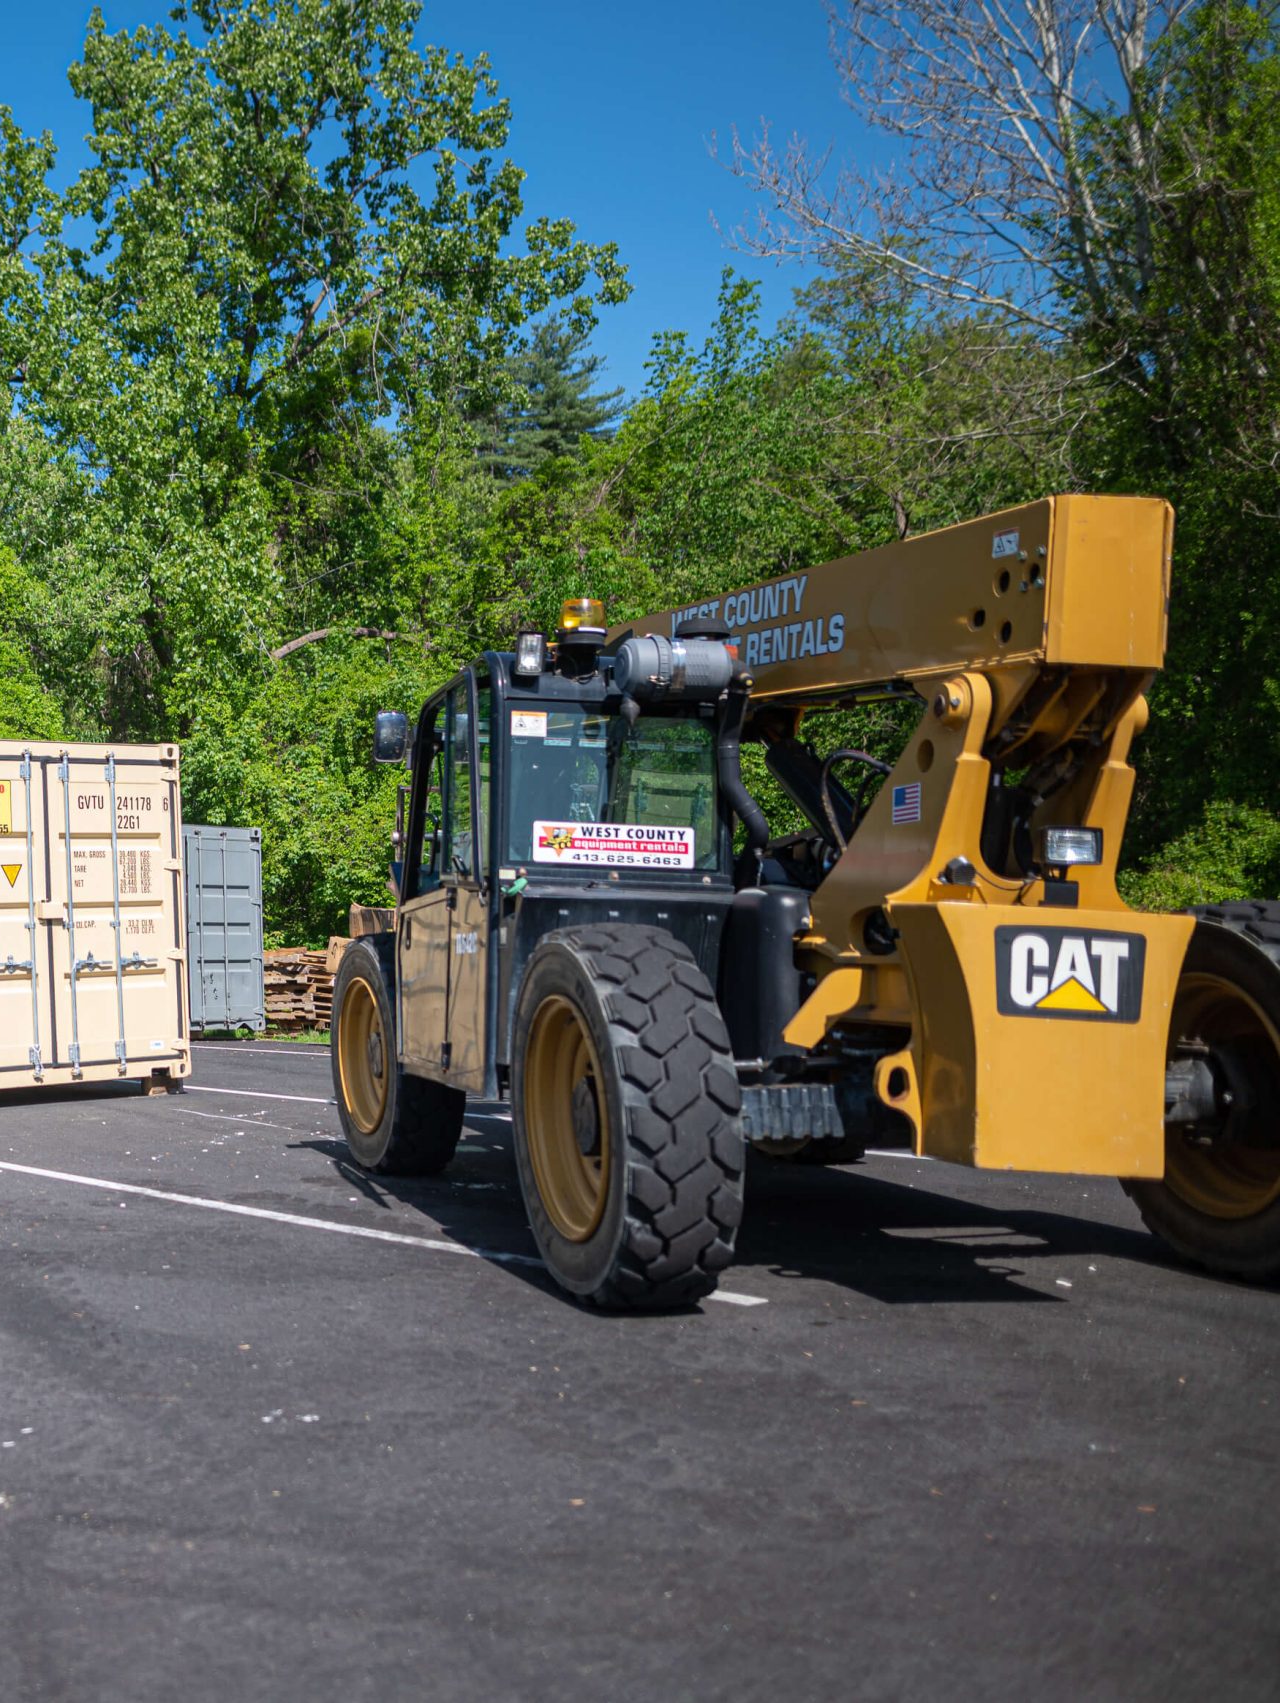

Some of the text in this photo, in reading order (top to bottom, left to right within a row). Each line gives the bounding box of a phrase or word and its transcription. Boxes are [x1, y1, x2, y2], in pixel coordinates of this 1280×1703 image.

[724, 575, 807, 629] COUNTY
[745, 614, 844, 667] RENTALS
[78, 795, 168, 811] GVTU 241178 6
[117, 815, 140, 829] 22G1
[581, 826, 686, 841] WEST COUNTY
[574, 839, 686, 852] equipment rentals
[572, 854, 681, 865] 413-625-6463
[75, 865, 86, 873] TARE
[1010, 932, 1129, 1014] CAT
